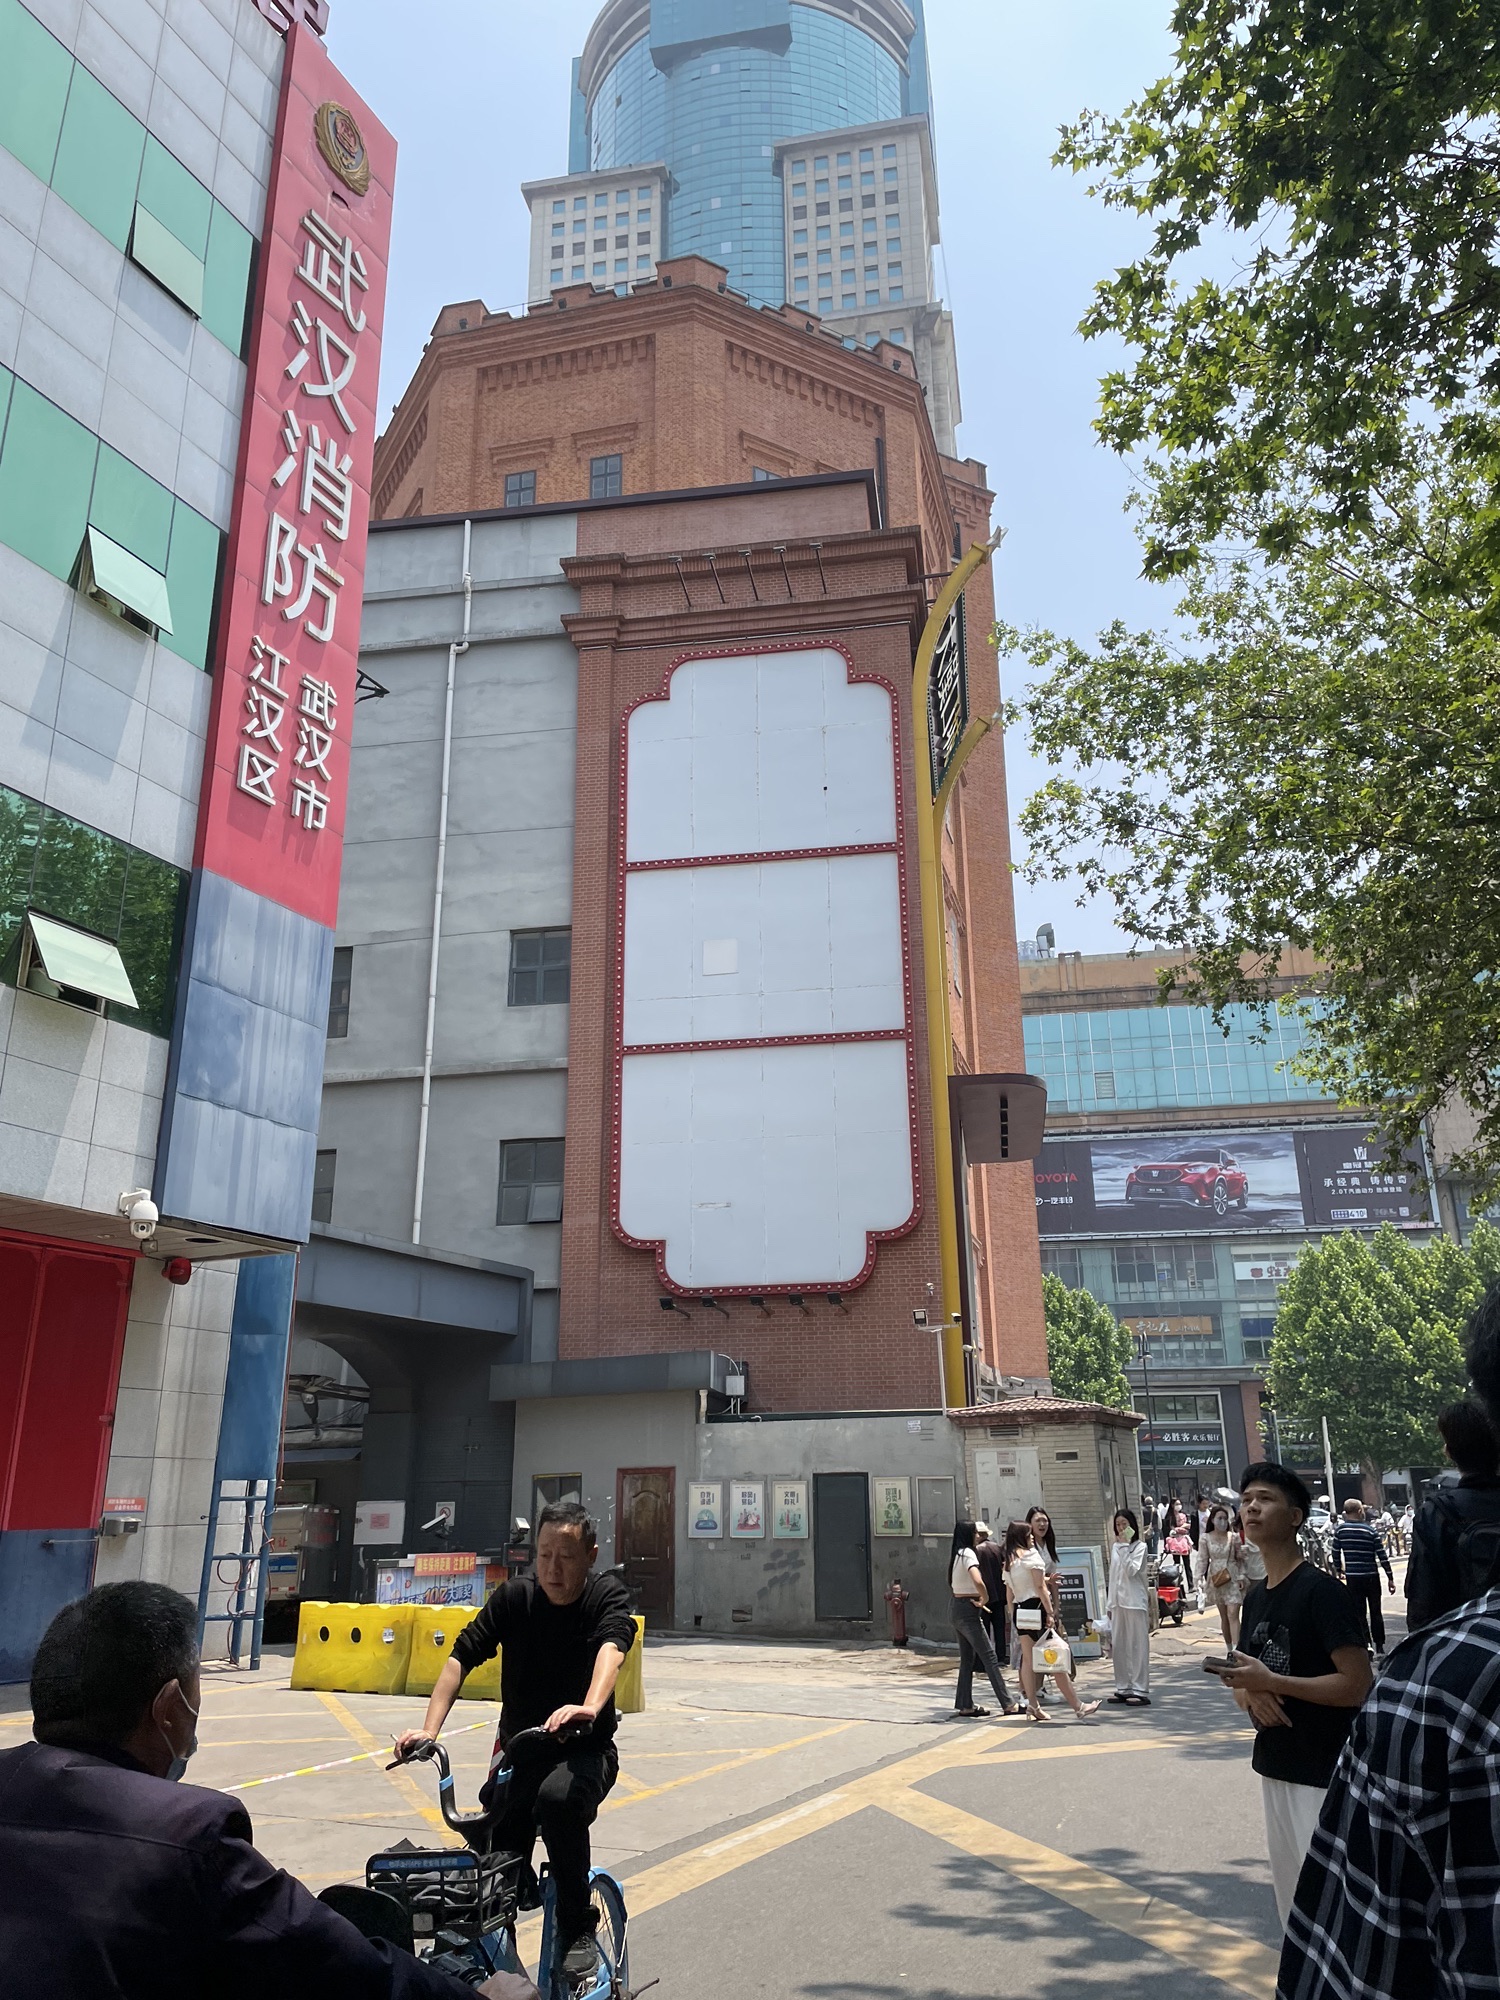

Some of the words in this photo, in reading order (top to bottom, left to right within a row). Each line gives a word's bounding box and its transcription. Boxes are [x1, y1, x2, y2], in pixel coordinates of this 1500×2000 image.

[262, 208, 369, 642] 武汉消防
[237, 635, 291, 806] 江汉区
[291, 673, 338, 830] 武汉市
[1034, 1173, 1078, 1183] OYOTA
[1323, 1177, 1360, 1187] 承经典
[1370, 1175, 1407, 1185] 铸传奇
[1162, 1432, 1190, 1442] 必胜客
[1192, 1434, 1220, 1442] 欢乐餐厅
[1183, 1456, 1206, 1466] Pizza
[1206, 1456, 1222, 1465] Hut
